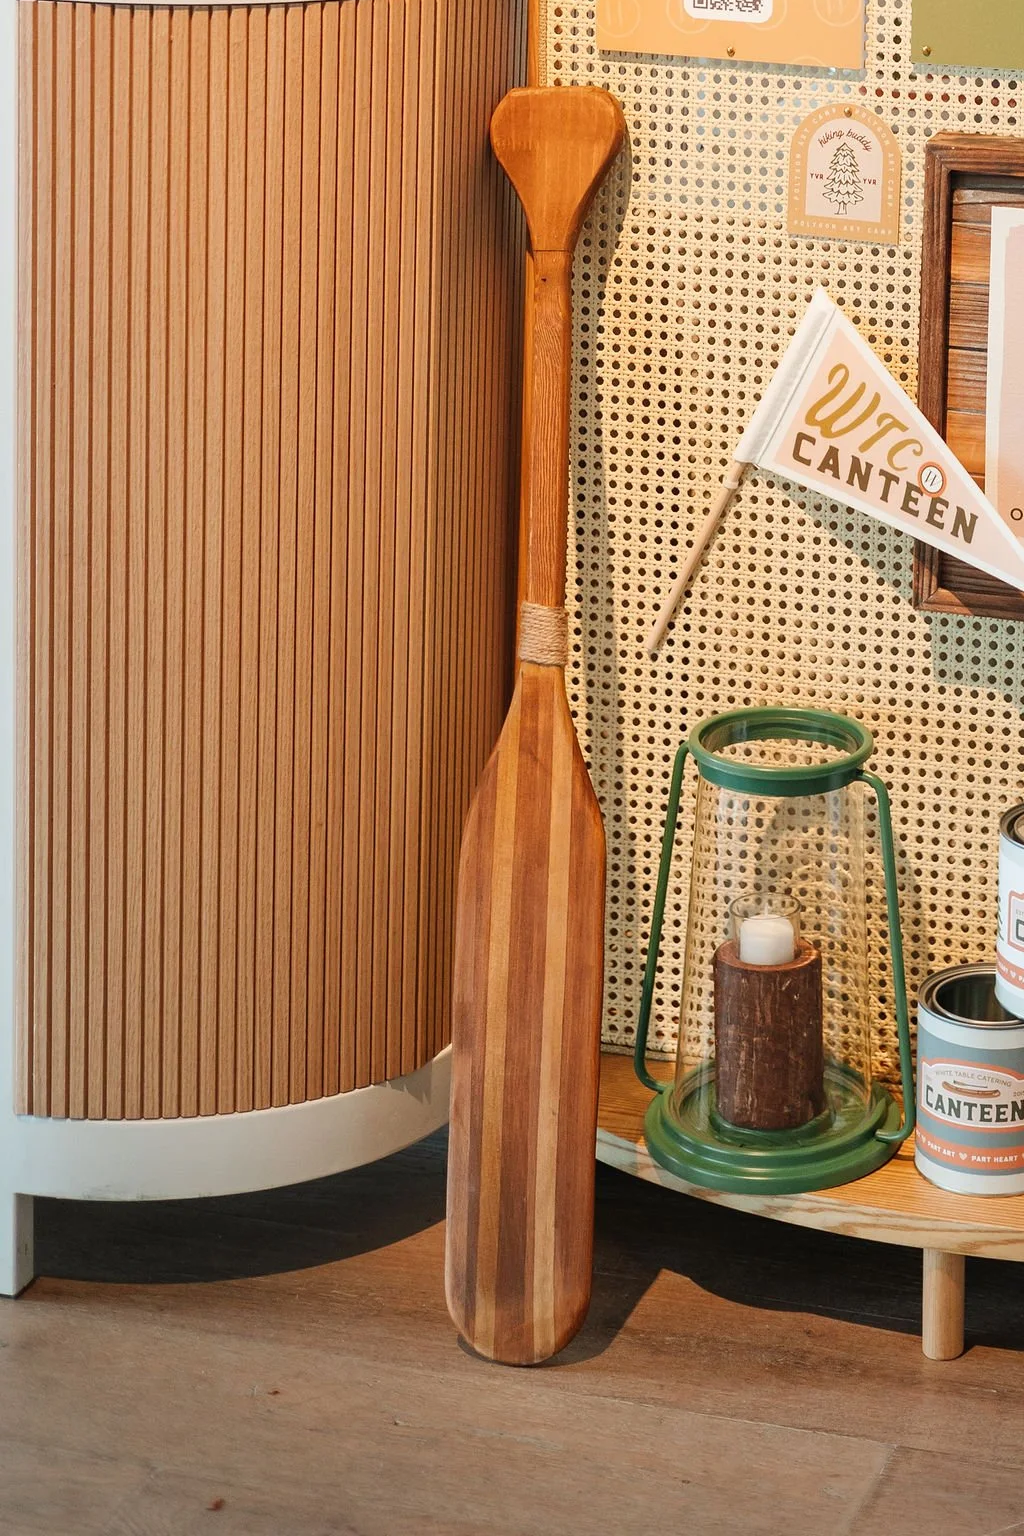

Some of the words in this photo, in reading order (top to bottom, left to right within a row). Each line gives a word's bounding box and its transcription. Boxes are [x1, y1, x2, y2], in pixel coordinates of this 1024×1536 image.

[818, 129, 845, 148] hiking
[846, 129, 872, 152] buddy
[810, 172, 824, 180] YVR
[804, 363, 924, 472] WTC
[792, 431, 979, 544] CANTEEN
[954, 1071, 975, 1079] TABLE
[976, 1074, 1012, 1087] CATERING
[927, 1140, 941, 1153] PART
[942, 1148, 956, 1158] ART
[971, 1155, 991, 1163] PART
[993, 1154, 1018, 1163] HEART
